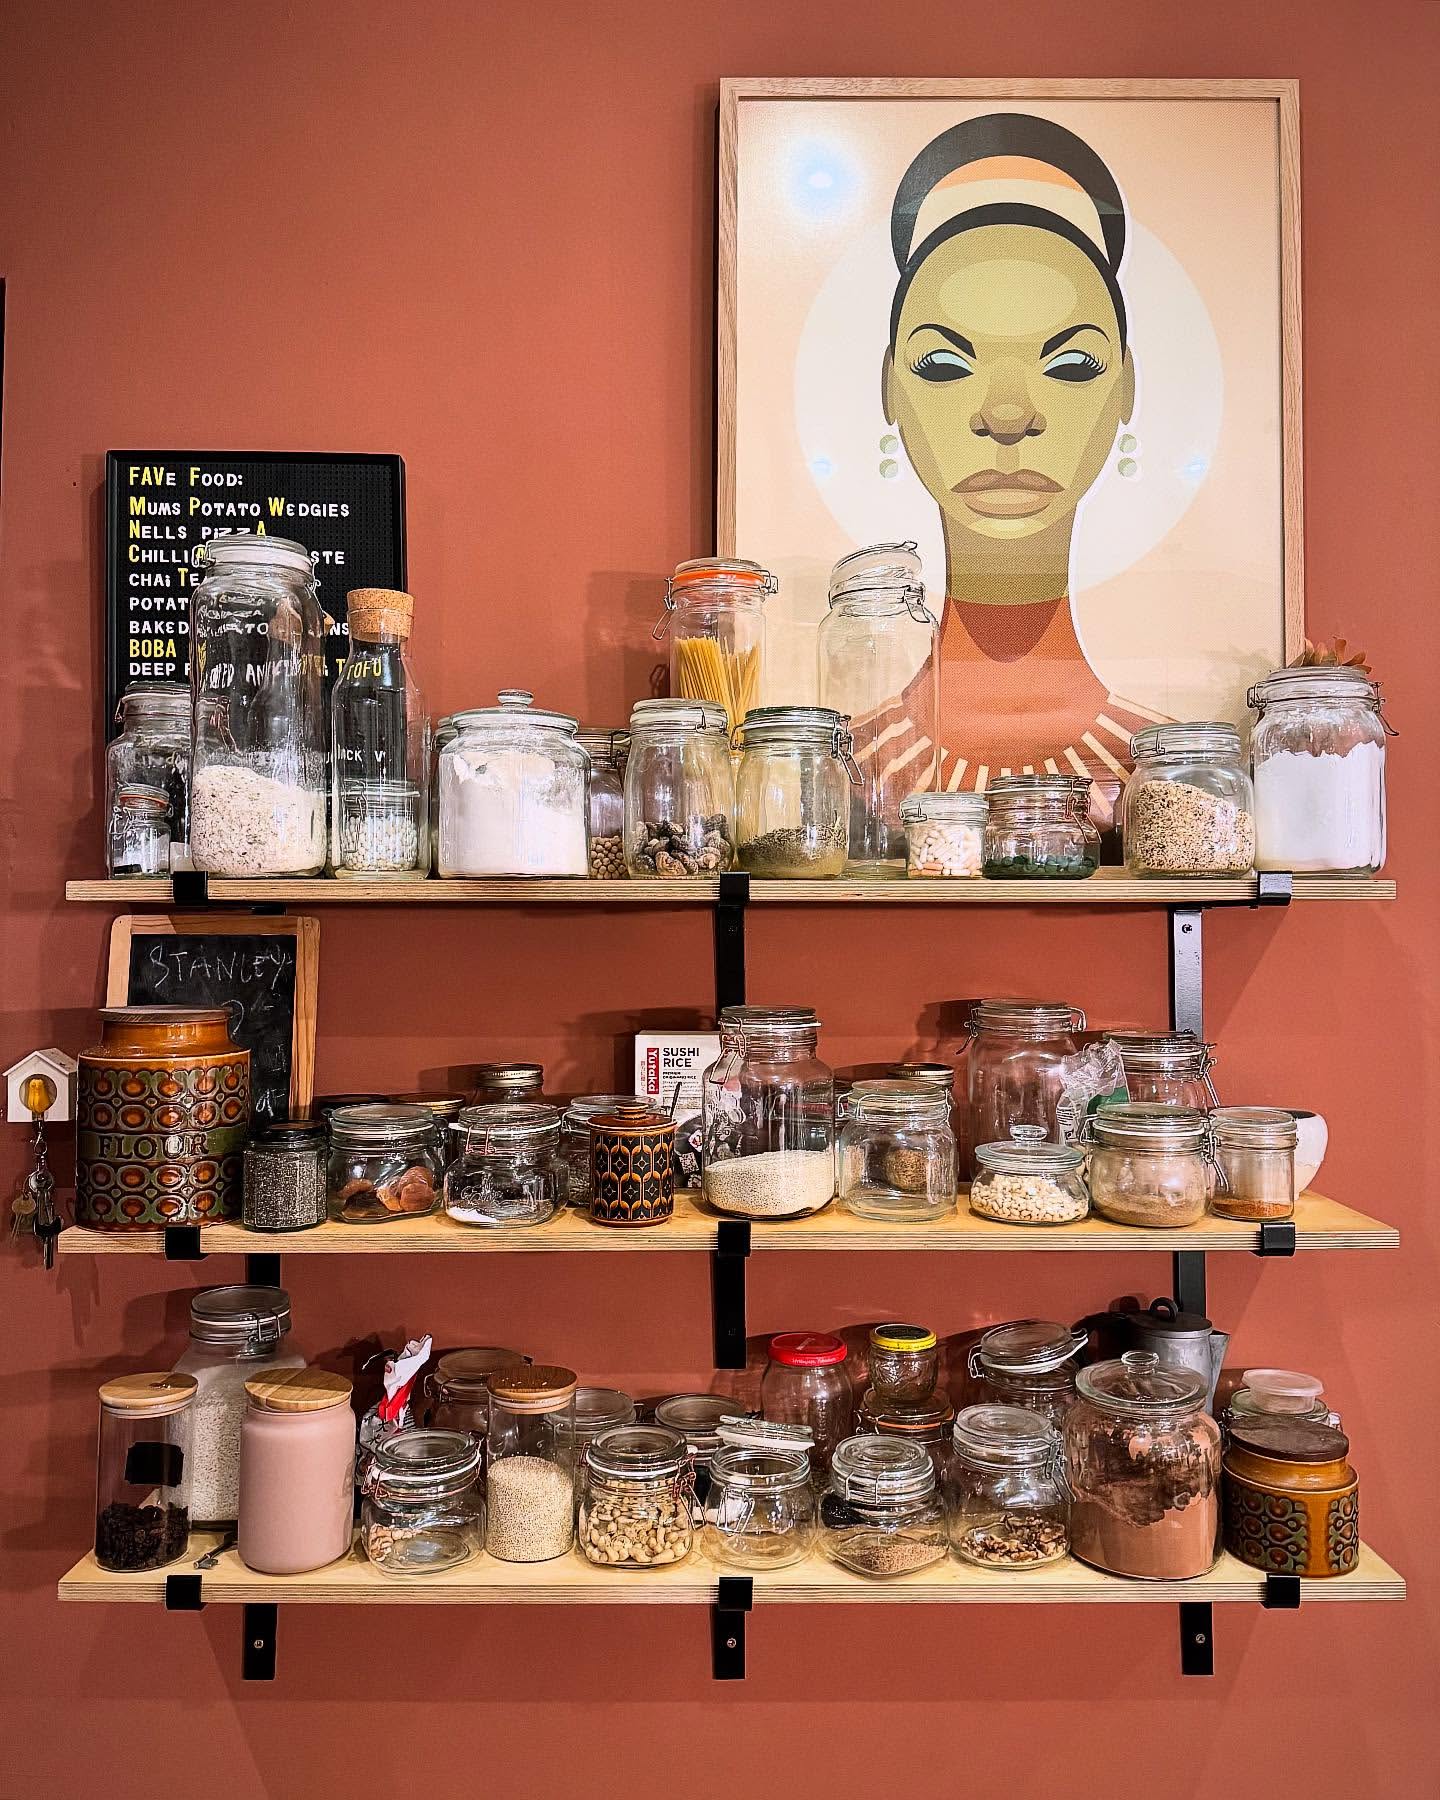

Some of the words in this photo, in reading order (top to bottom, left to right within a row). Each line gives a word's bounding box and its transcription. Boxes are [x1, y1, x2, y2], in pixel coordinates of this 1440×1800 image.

[189, 467, 243, 487] FOOD:
[129, 497, 181, 516] MUMS
[189, 497, 261, 517] POTATO
[268, 497, 350, 517] WEDGIES
[129, 520, 187, 539] NELLS
[129, 544, 189, 563] CHILLI
[177, 568, 206, 587] TE
[129, 597, 190, 611] POTAT
[129, 620, 190, 635] BAKED
[129, 639, 177, 658] BOBA
[129, 662, 176, 676] DEEP
[149, 945, 289, 989] STANLEY
[662, 1048, 700, 1057] SUSHI
[648, 1049, 658, 1092] Yutaka
[663, 1058, 692, 1068] RICE
[98, 1134, 210, 1159] FLOUR
